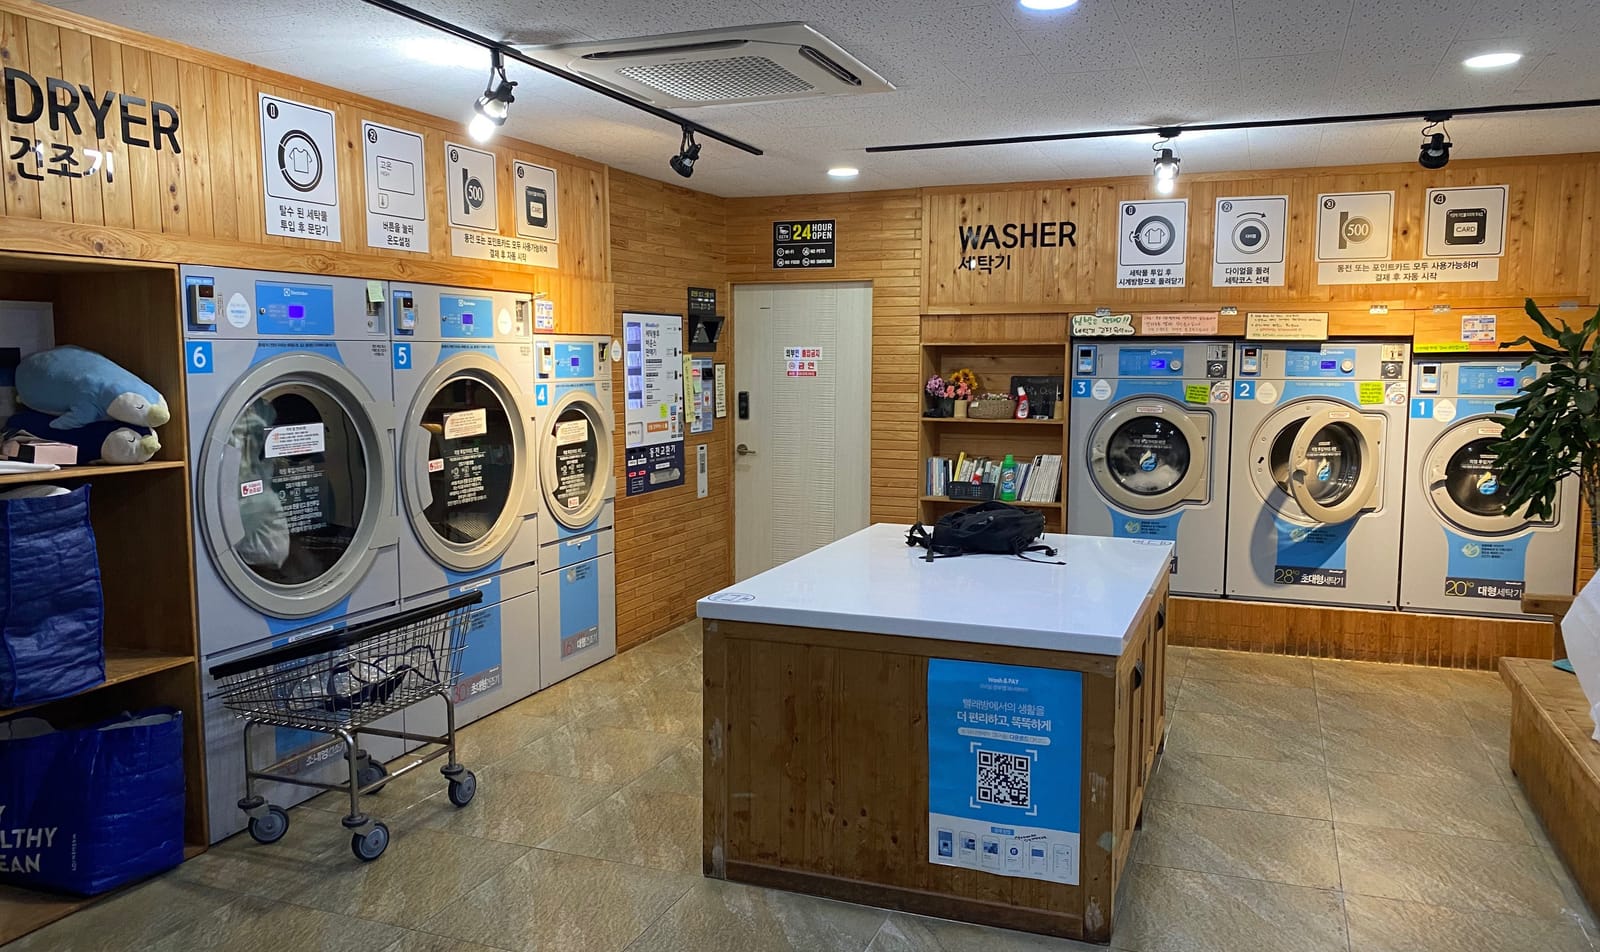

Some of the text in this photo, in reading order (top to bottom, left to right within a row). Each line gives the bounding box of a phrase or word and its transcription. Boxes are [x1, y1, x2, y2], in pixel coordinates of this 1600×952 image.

[5, 67, 181, 153] DRYER
[10, 136, 114, 183] 건조기
[468, 185, 483, 201] 500
[280, 205, 327, 222] 탈수 된 세탁물
[280, 219, 328, 236] 투입 후 문닫기
[792, 224, 811, 240] 24
[812, 223, 832, 231] HOUR
[1346, 224, 1369, 236] 500
[387, 235, 411, 248] 온도설정
[464, 233, 474, 243] 동전
[476, 235, 485, 245] 또는
[488, 237, 511, 248] 포인트카드
[512, 241, 520, 249] 모두
[812, 231, 832, 239] OPEN
[958, 221, 1077, 253] WASHER
[501, 250, 505, 259] 후
[507, 251, 516, 261] 자동
[958, 255, 1011, 275] 세탁기
[1225, 266, 1270, 275] 다이얼을 돌려
[1337, 261, 1479, 272] 동전 또는 포인트카드 모두 사용가능하며
[1118, 277, 1184, 286] 시계방향으로 돌려닫기
[1224, 276, 1270, 284] 세탁코스 선택
[1375, 272, 1437, 281] 결제 후 자동 시작
[193, 346, 206, 368] 6
[398, 347, 407, 365] 5
[1077, 382, 1085, 394] 3
[1239, 384, 1248, 397] 2
[537, 388, 545, 403] 4
[1418, 401, 1425, 415] 1
[649, 444, 676, 458] 동전교환기
[1477, 586, 1522, 598] 대형세탁기
[962, 698, 1045, 717] 빨래방에서의 생활을
[957, 711, 1052, 732] 더 편리하고, 똑똑하게
[0, 827, 58, 848] LTHY
